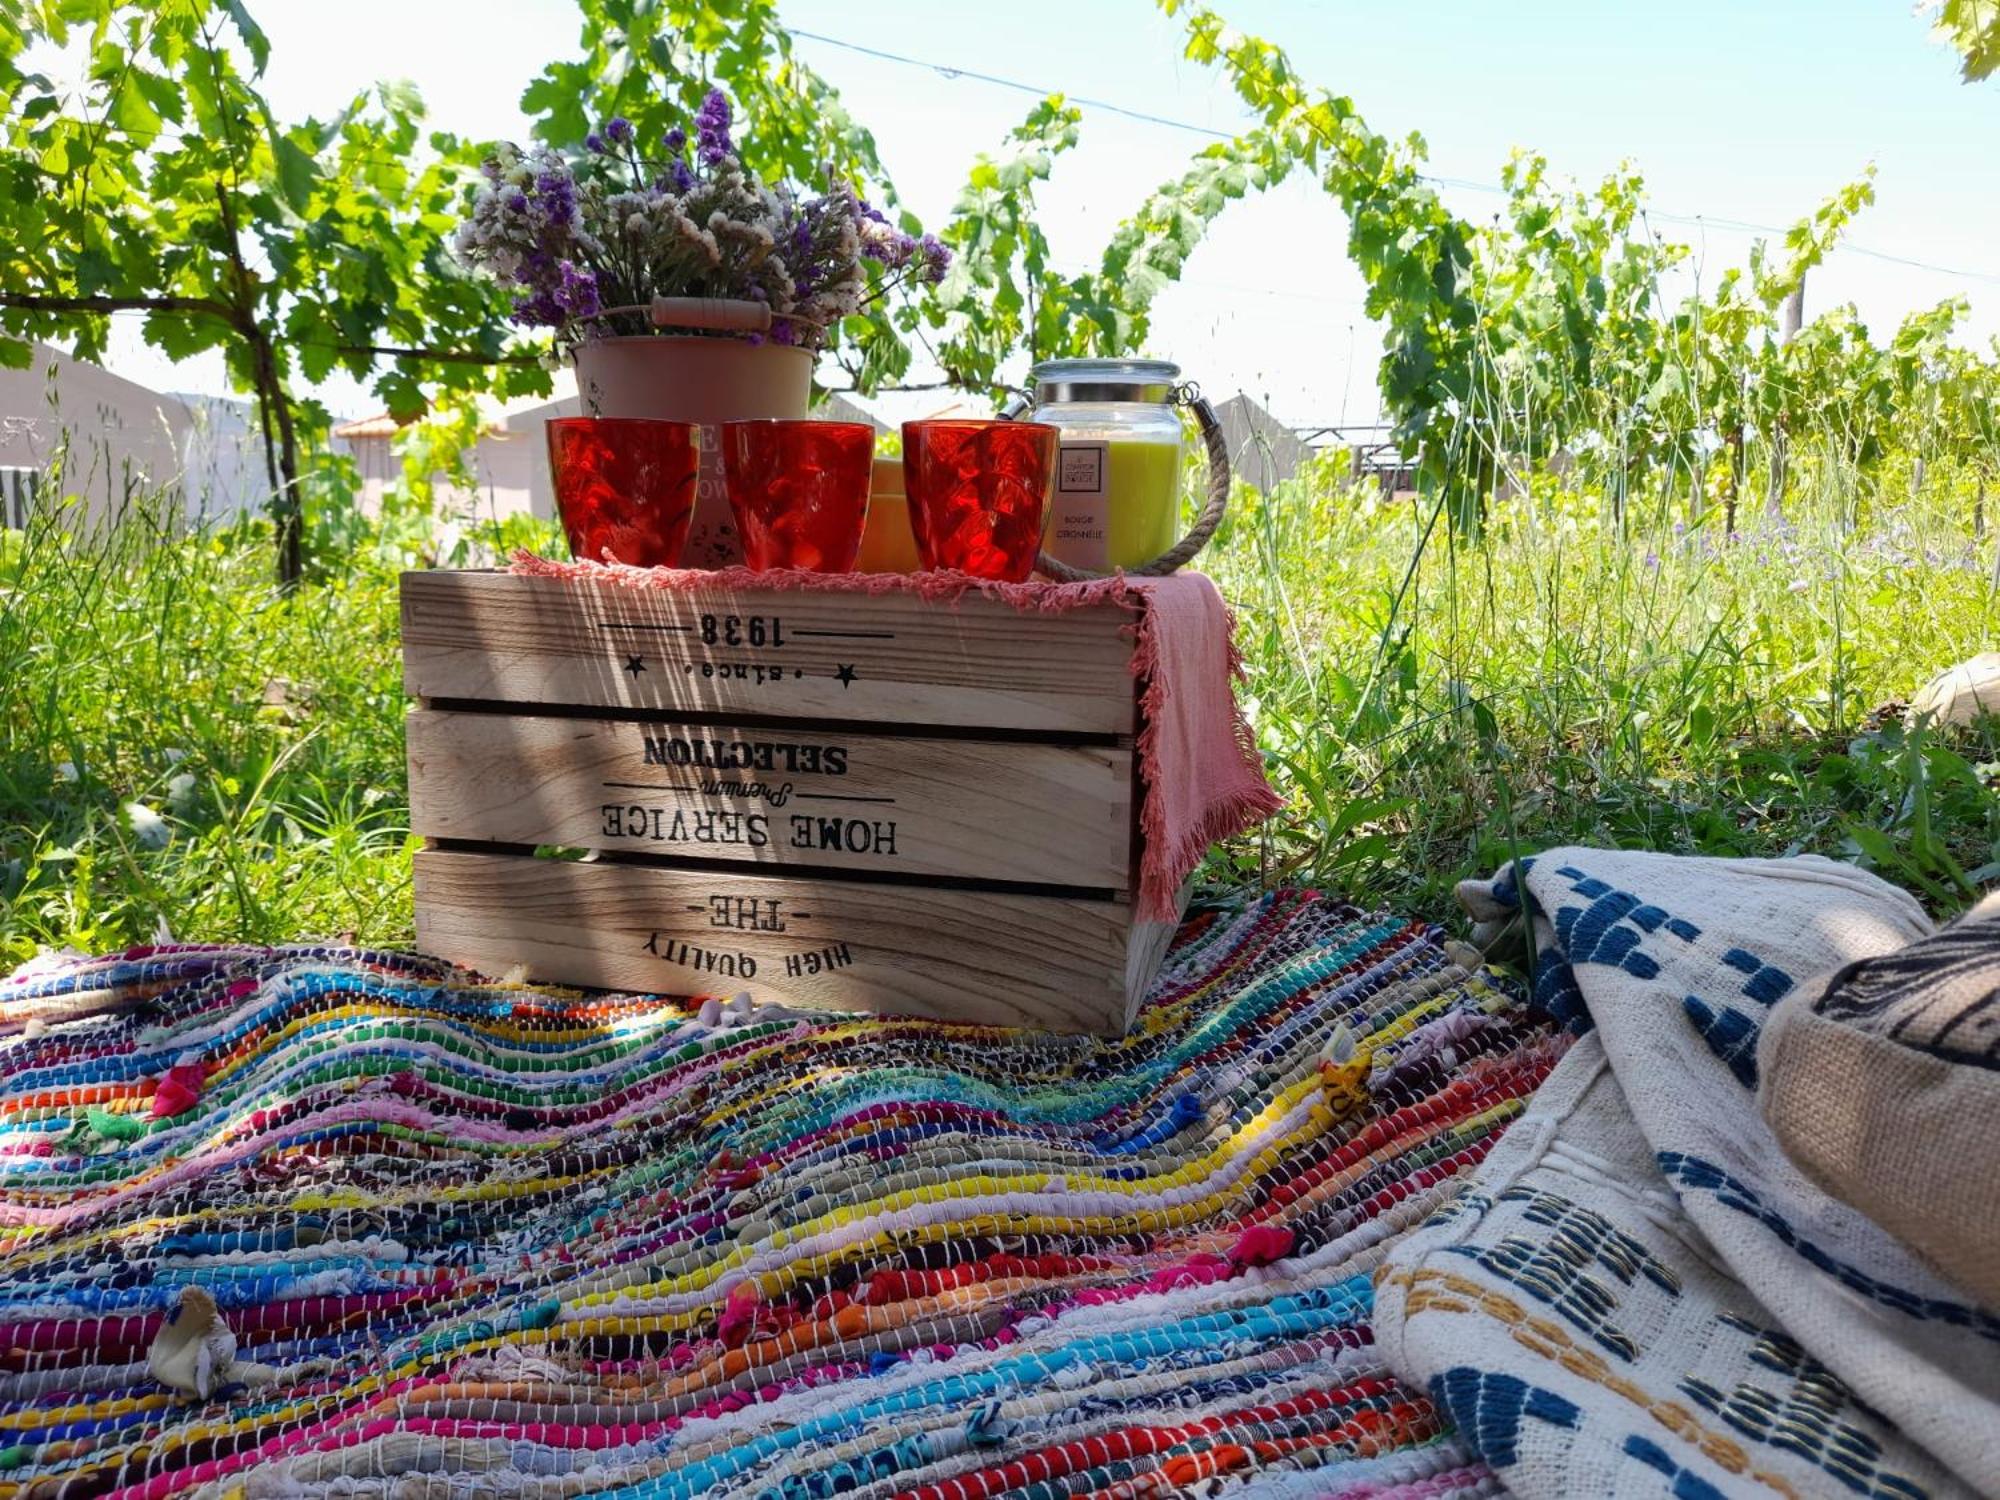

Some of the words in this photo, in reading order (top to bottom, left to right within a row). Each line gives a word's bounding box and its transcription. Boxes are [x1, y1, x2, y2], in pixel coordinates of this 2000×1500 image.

[701, 614, 785, 648] 1938
[702, 662, 784, 685] since
[643, 736, 849, 776] SELECTION
[700, 779, 793, 808] Premium
[602, 804, 769, 848] SERVICE
[790, 814, 898, 855] HOME
[709, 895, 786, 932] THE
[642, 931, 757, 978] QUALITY
[784, 942, 853, 978] HIGH
